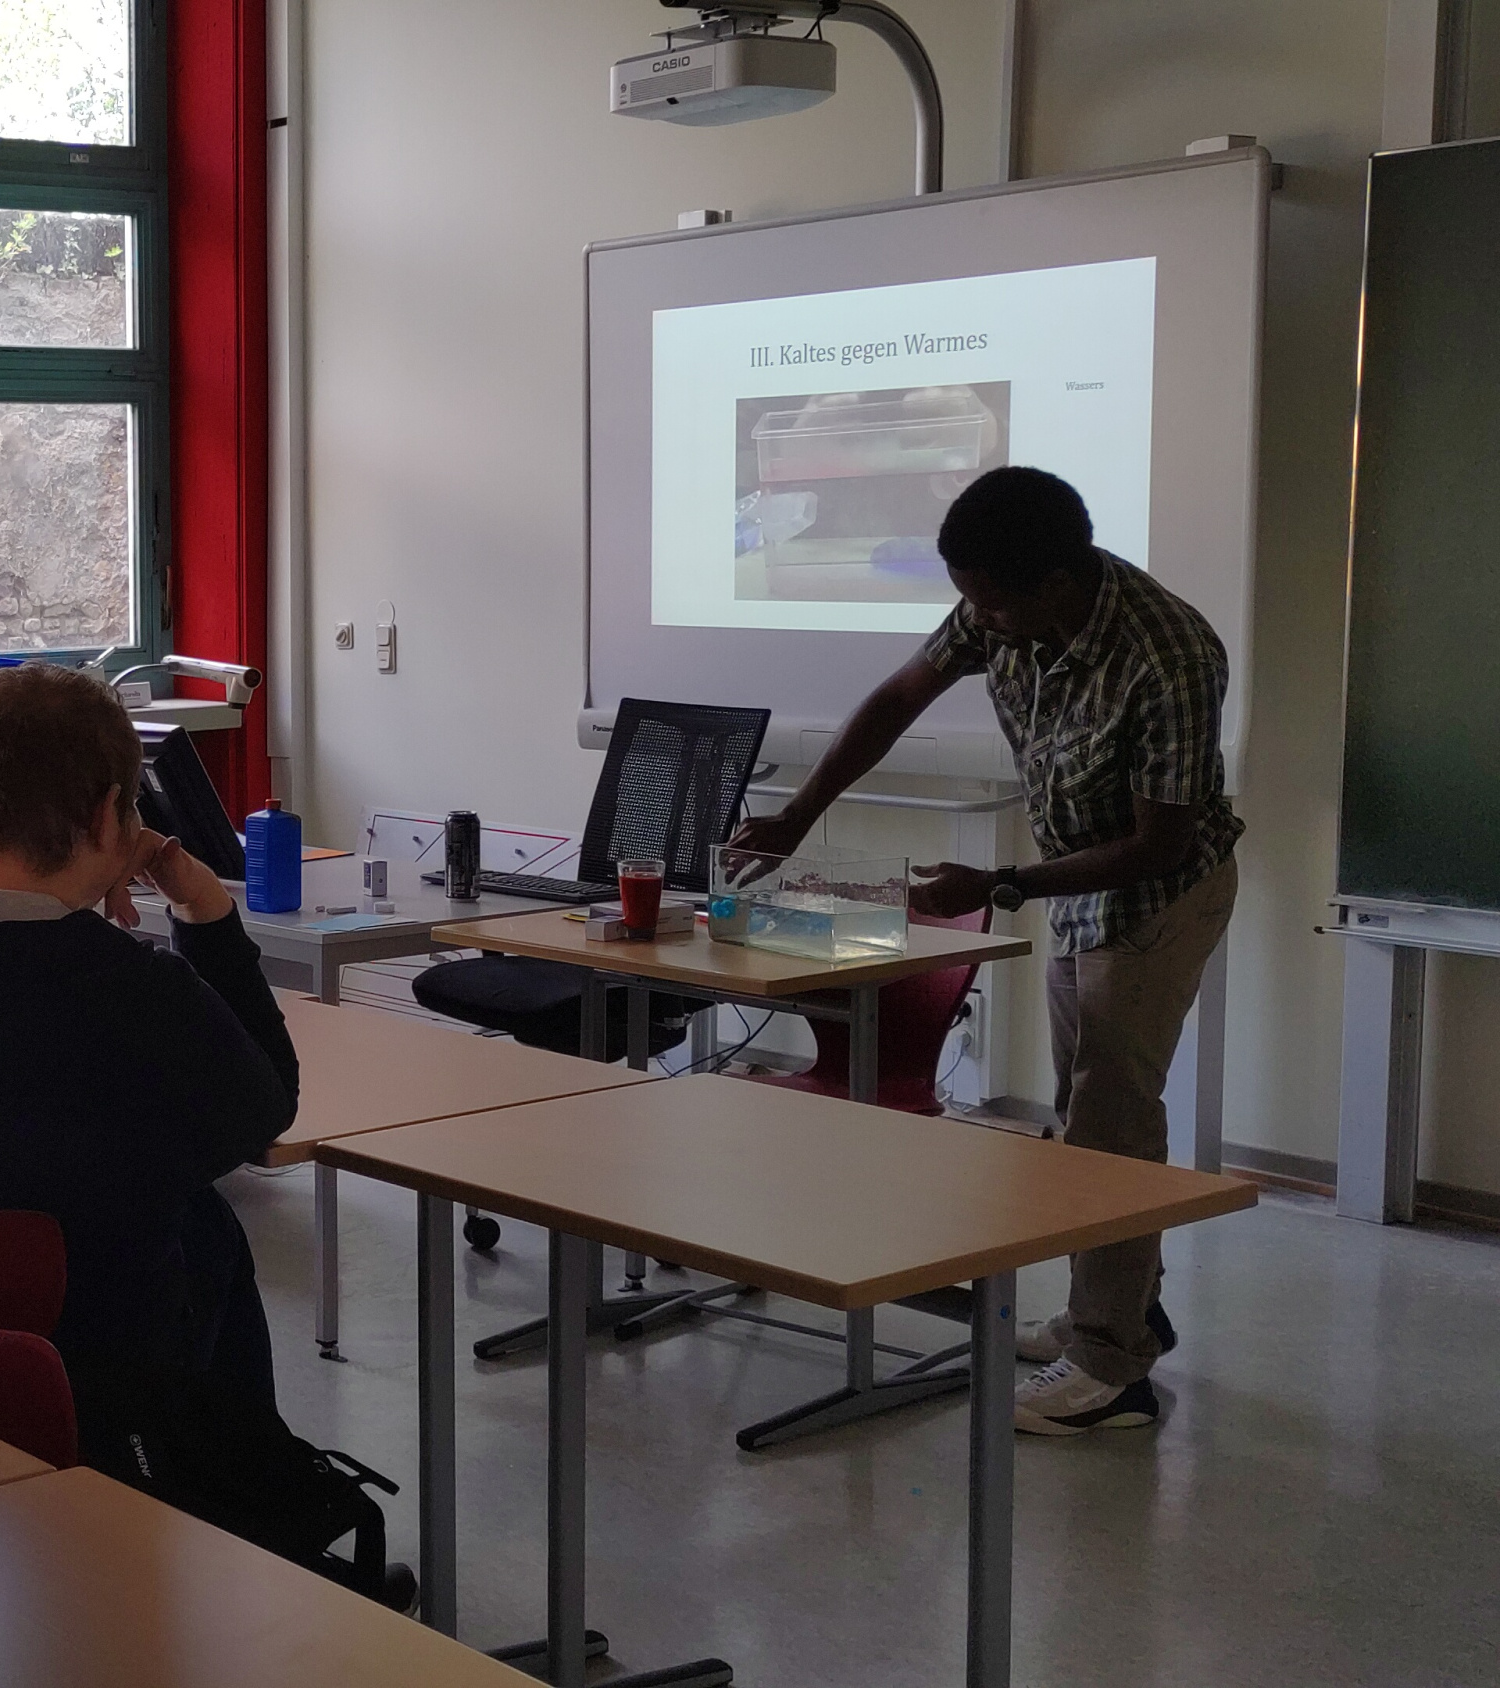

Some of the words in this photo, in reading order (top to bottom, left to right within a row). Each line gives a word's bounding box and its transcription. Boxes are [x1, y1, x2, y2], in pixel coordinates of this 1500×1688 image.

[652, 56, 691, 73] CASIO
[750, 346, 775, 368] III.
[779, 343, 836, 366] Kaltes
[841, 341, 898, 366] gegen
[903, 333, 988, 355] Warmes
[1065, 381, 1104, 391] Wassers
